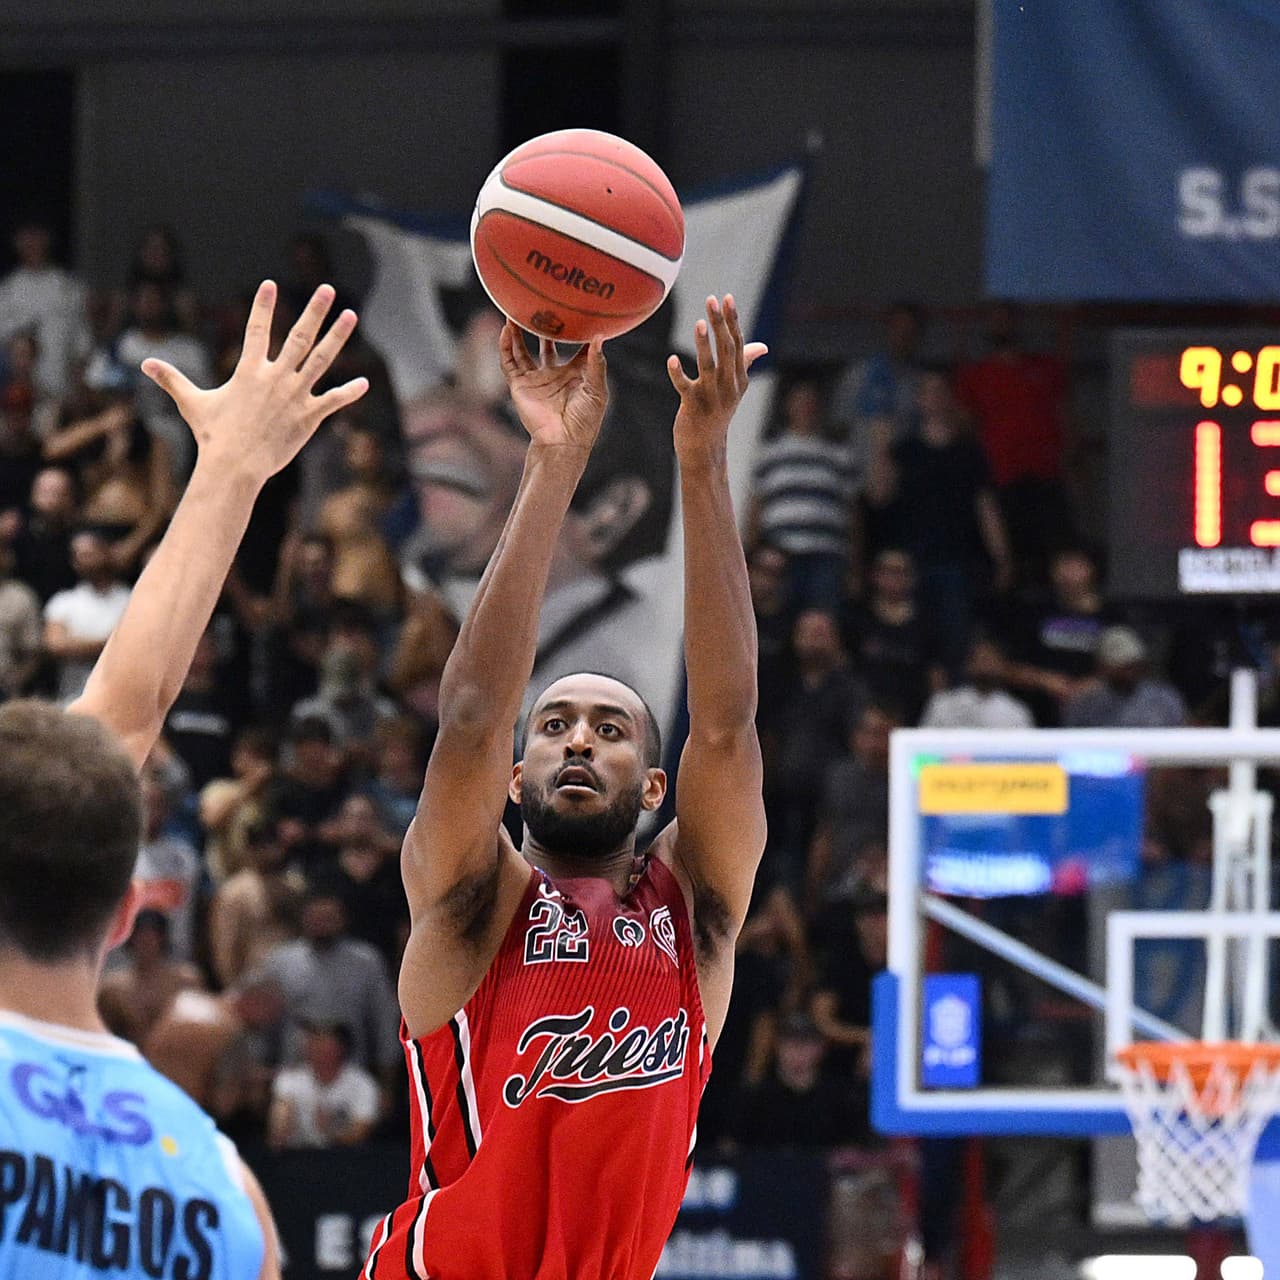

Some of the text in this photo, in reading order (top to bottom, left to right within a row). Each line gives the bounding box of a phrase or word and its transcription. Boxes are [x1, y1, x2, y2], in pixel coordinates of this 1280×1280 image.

[526, 249, 616, 301] molten
[524, 898, 589, 965] 22
[503, 1005, 690, 1108] Triest
